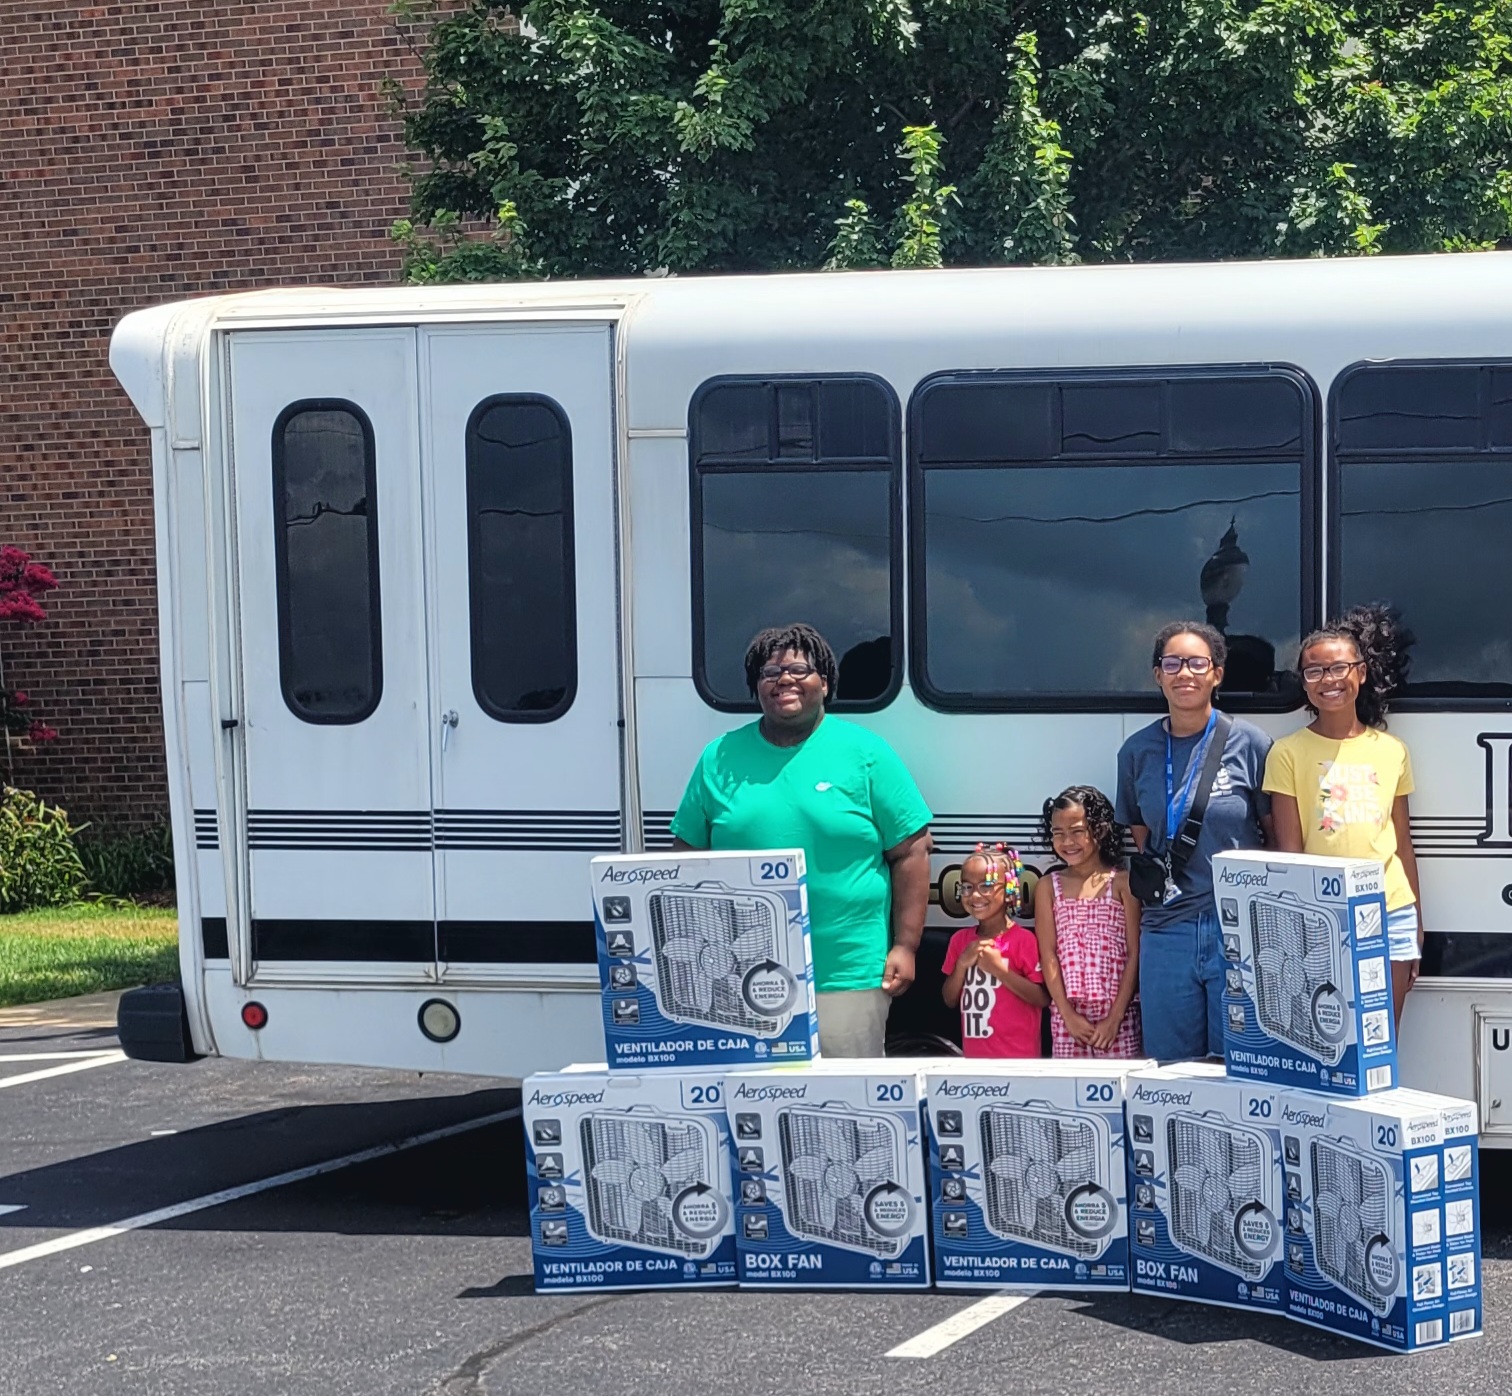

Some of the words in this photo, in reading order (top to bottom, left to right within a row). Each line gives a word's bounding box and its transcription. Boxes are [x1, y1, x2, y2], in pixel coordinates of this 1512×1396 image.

[600, 865, 681, 885] Aerospeed
[1219, 866, 1268, 888] Aerospeed
[1355, 882, 1379, 893] BX100
[964, 964, 997, 987] US
[962, 987, 990, 1011] DO
[966, 1012, 989, 1037] IT.
[614, 1040, 694, 1054] VENTILADOR
[697, 1040, 715, 1051] DE
[717, 1037, 750, 1050] CAJA
[616, 1055, 646, 1064] modelo
[647, 1054, 676, 1063] BX100
[1229, 1050, 1280, 1067] VENTILADOR
[1281, 1058, 1294, 1070] DE
[1295, 1060, 1317, 1074] CAJA
[528, 1089, 604, 1108] Aerospeed
[734, 1082, 807, 1102] Aerospeed
[935, 1079, 1010, 1099] Aerospeed
[1132, 1084, 1192, 1107] Aerospeed
[1281, 1104, 1326, 1129] Aerospeed
[1445, 1124, 1470, 1135] BX100
[1411, 1134, 1436, 1145] BX100
[543, 1261, 623, 1275] VENTILADOR
[626, 1261, 643, 1271] DE
[645, 1259, 678, 1271] CAJA
[745, 1253, 783, 1269] BOX
[787, 1253, 823, 1269] FAN
[943, 1256, 1018, 1269] VENTILADOR
[1021, 1258, 1037, 1268] DE
[1040, 1258, 1070, 1270] CAJA
[543, 1276, 574, 1284] modelo
[576, 1274, 604, 1283] BX100
[745, 1270, 769, 1278] model
[944, 1269, 972, 1277] modelo
[973, 1269, 1000, 1278] BX100
[1136, 1259, 1167, 1277] BOX
[1170, 1265, 1198, 1283] FAN
[1289, 1289, 1335, 1312] VENTILADOR
[1336, 1303, 1347, 1316] DE
[1348, 1306, 1369, 1323] CAJA
